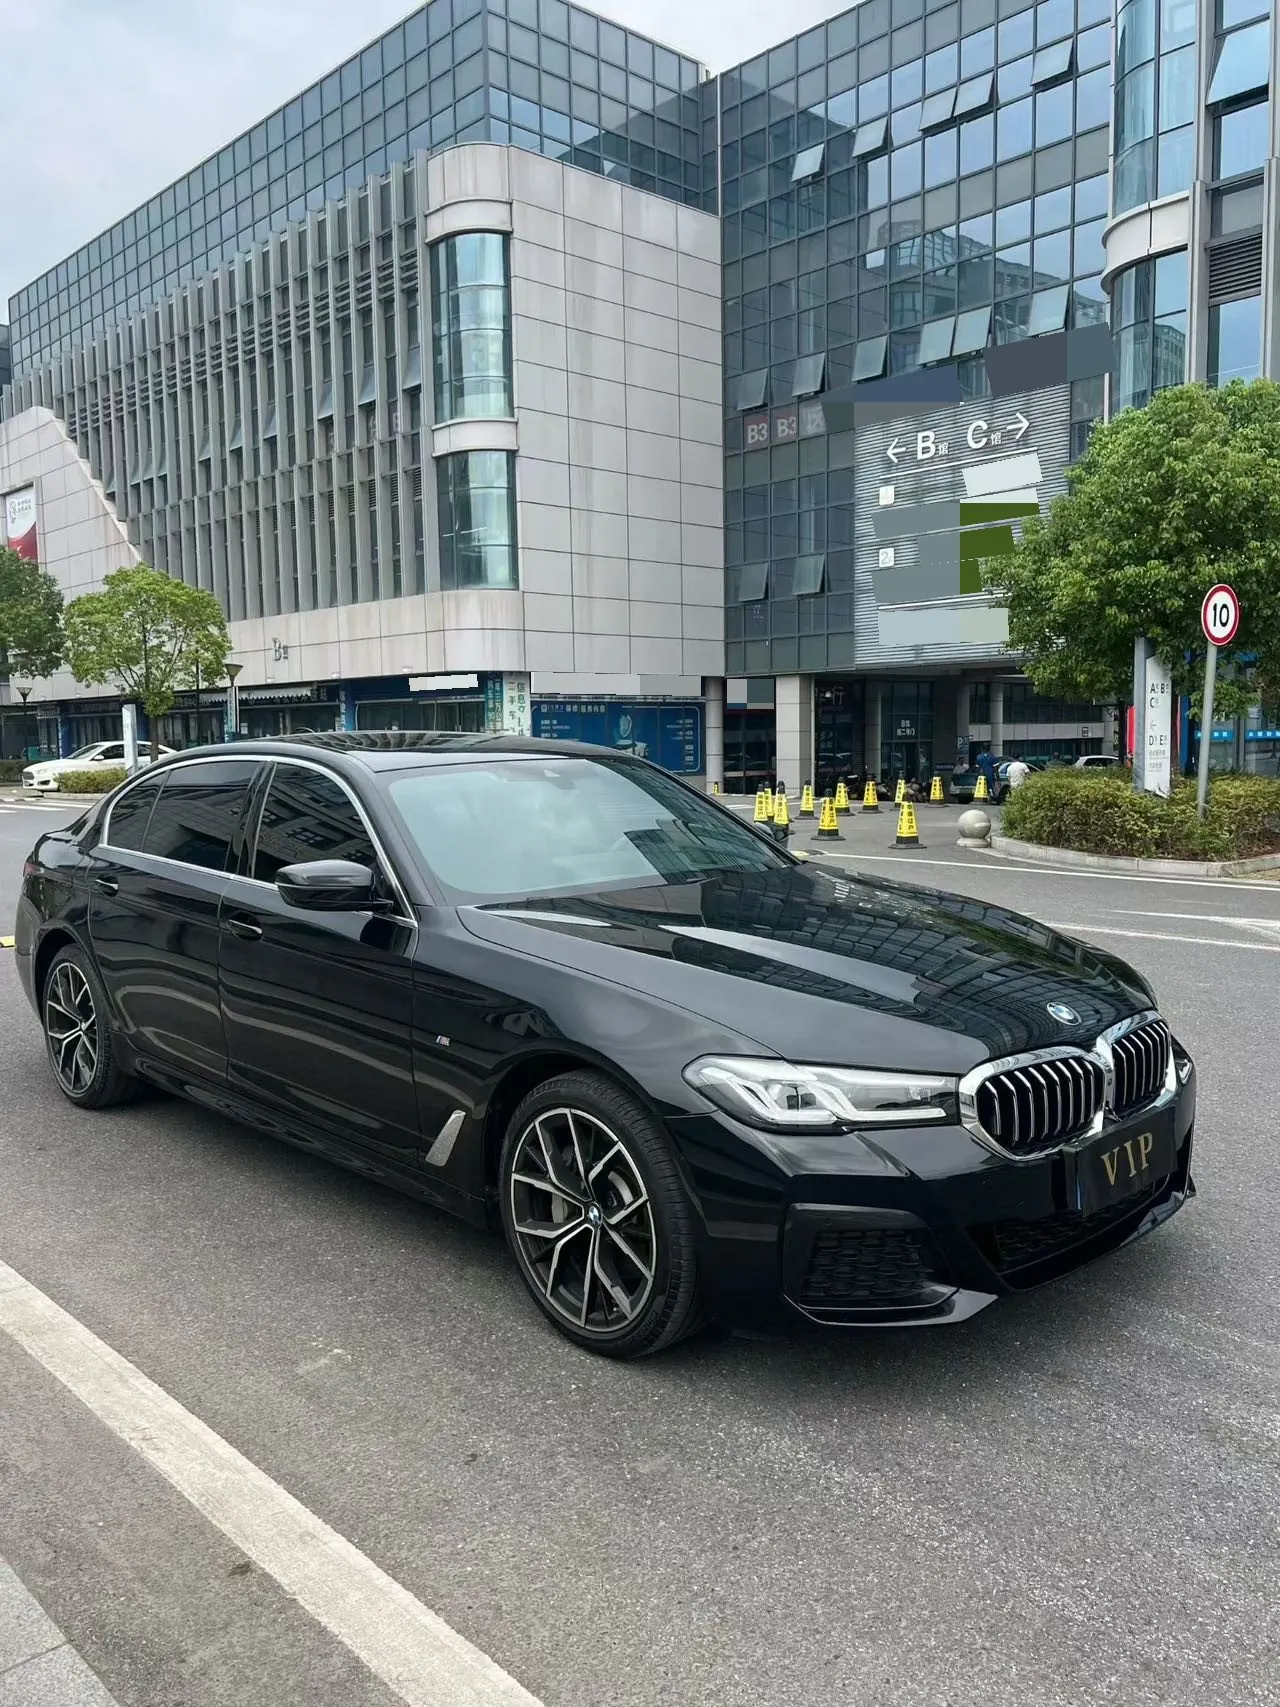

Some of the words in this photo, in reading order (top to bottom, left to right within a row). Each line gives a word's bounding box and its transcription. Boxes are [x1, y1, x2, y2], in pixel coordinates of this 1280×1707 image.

[747, 423, 767, 444] B3
[777, 416, 796, 438] B3
[917, 430, 949, 460] B馆
[967, 420, 1002, 449] C馆
[1212, 603, 1230, 627] 10
[1101, 1131, 1153, 1186] VIP
